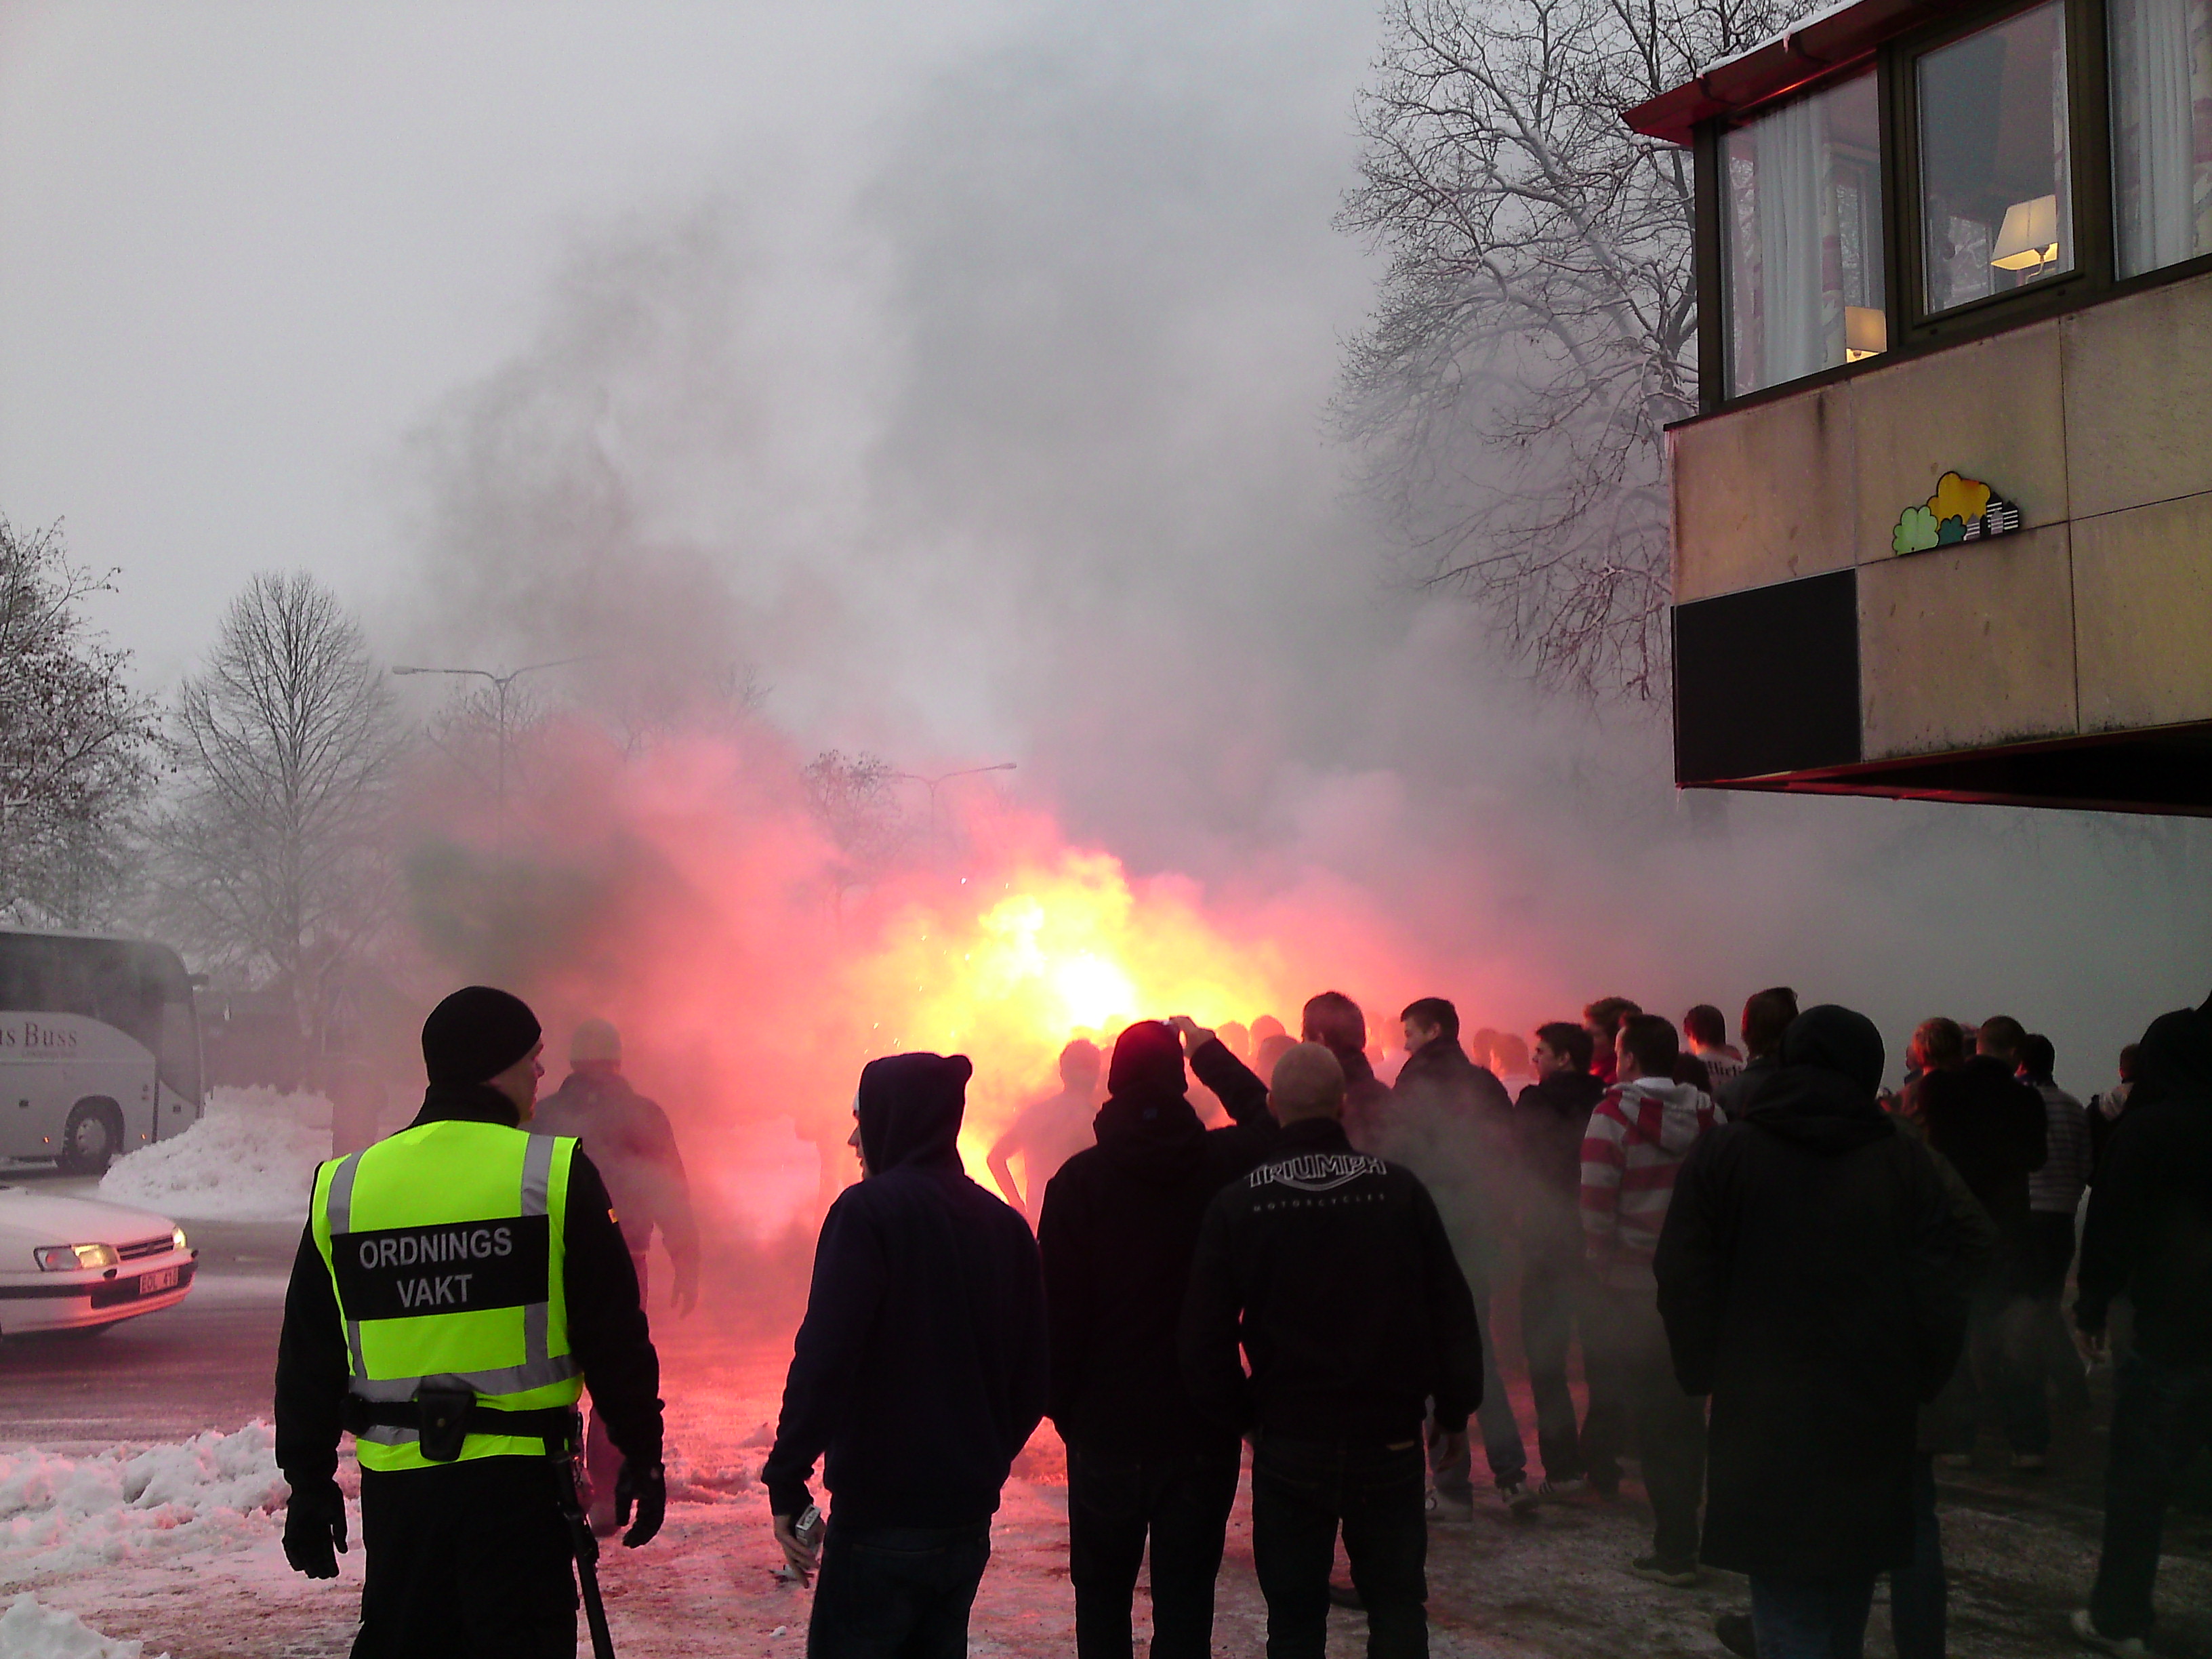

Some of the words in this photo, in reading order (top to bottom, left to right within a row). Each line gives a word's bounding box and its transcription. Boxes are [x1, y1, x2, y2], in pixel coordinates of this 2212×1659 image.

[0, 1028, 16, 1046] s
[24, 1022, 77, 1046] Buss
[1246, 1154, 1387, 1189] TRIUMPH
[1253, 1193, 1385, 1212] MOTORCYCLES
[359, 1227, 512, 1269] ORDNINGS
[396, 1274, 473, 1307] VAKT
